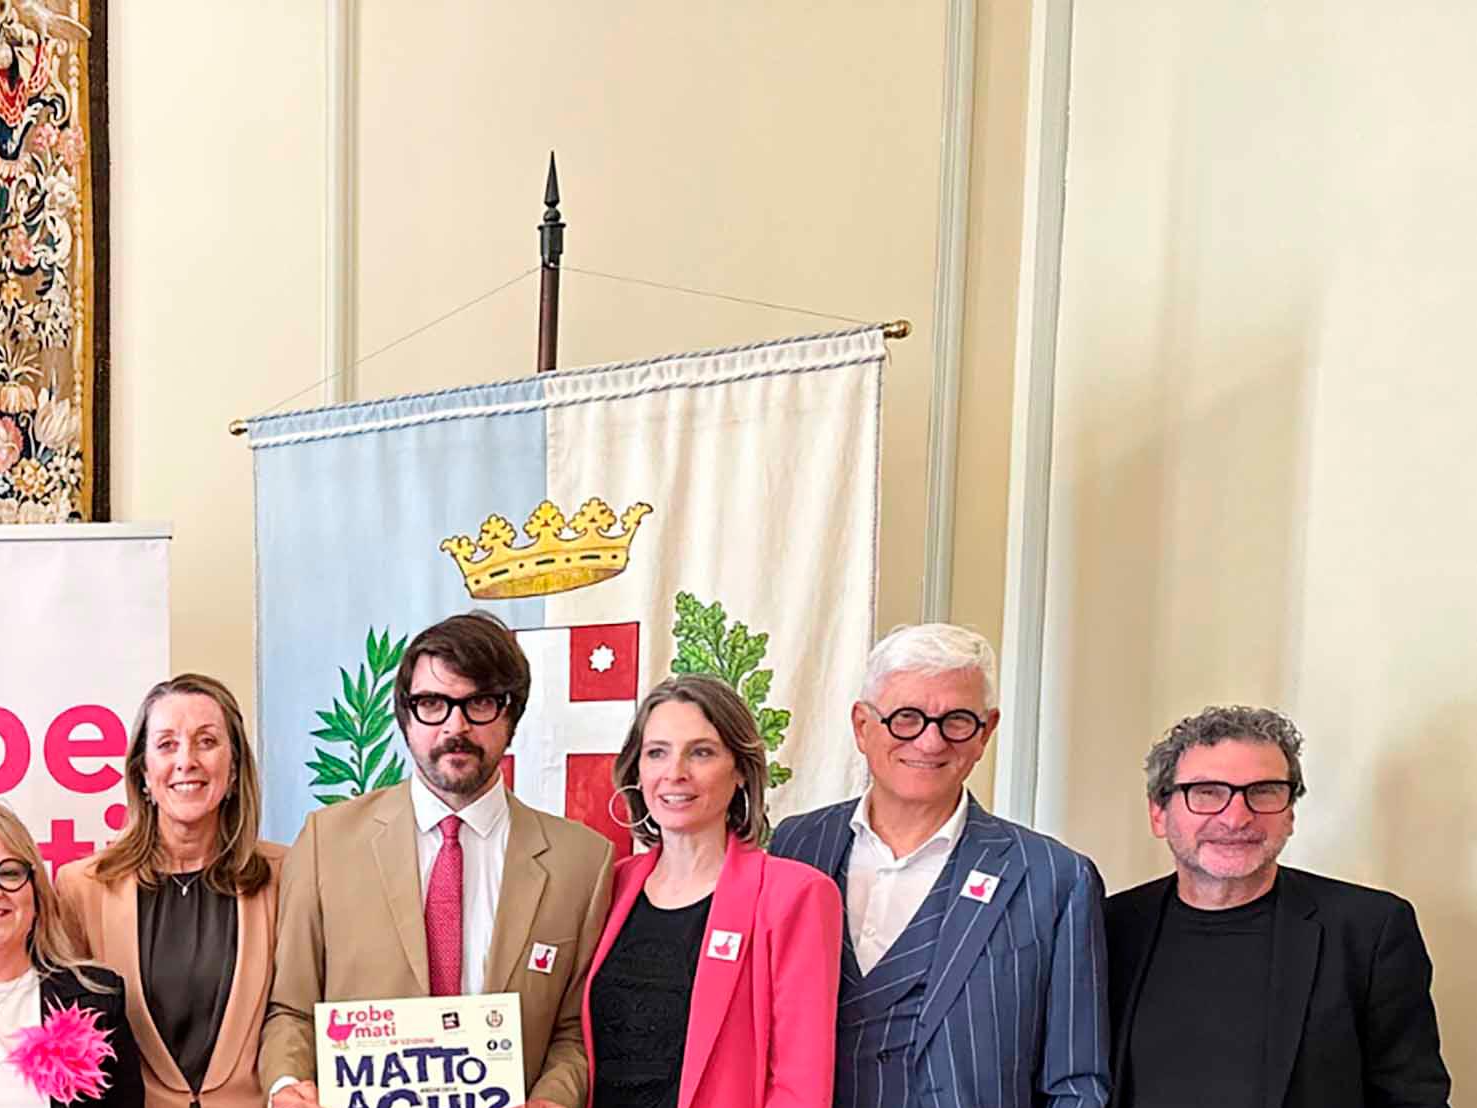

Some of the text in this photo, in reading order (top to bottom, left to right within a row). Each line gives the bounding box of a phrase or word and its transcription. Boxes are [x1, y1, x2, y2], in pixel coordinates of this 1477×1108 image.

[347, 1005, 394, 1023] robe
[355, 1022, 396, 1039] mati
[335, 1046, 487, 1088] MATTO
